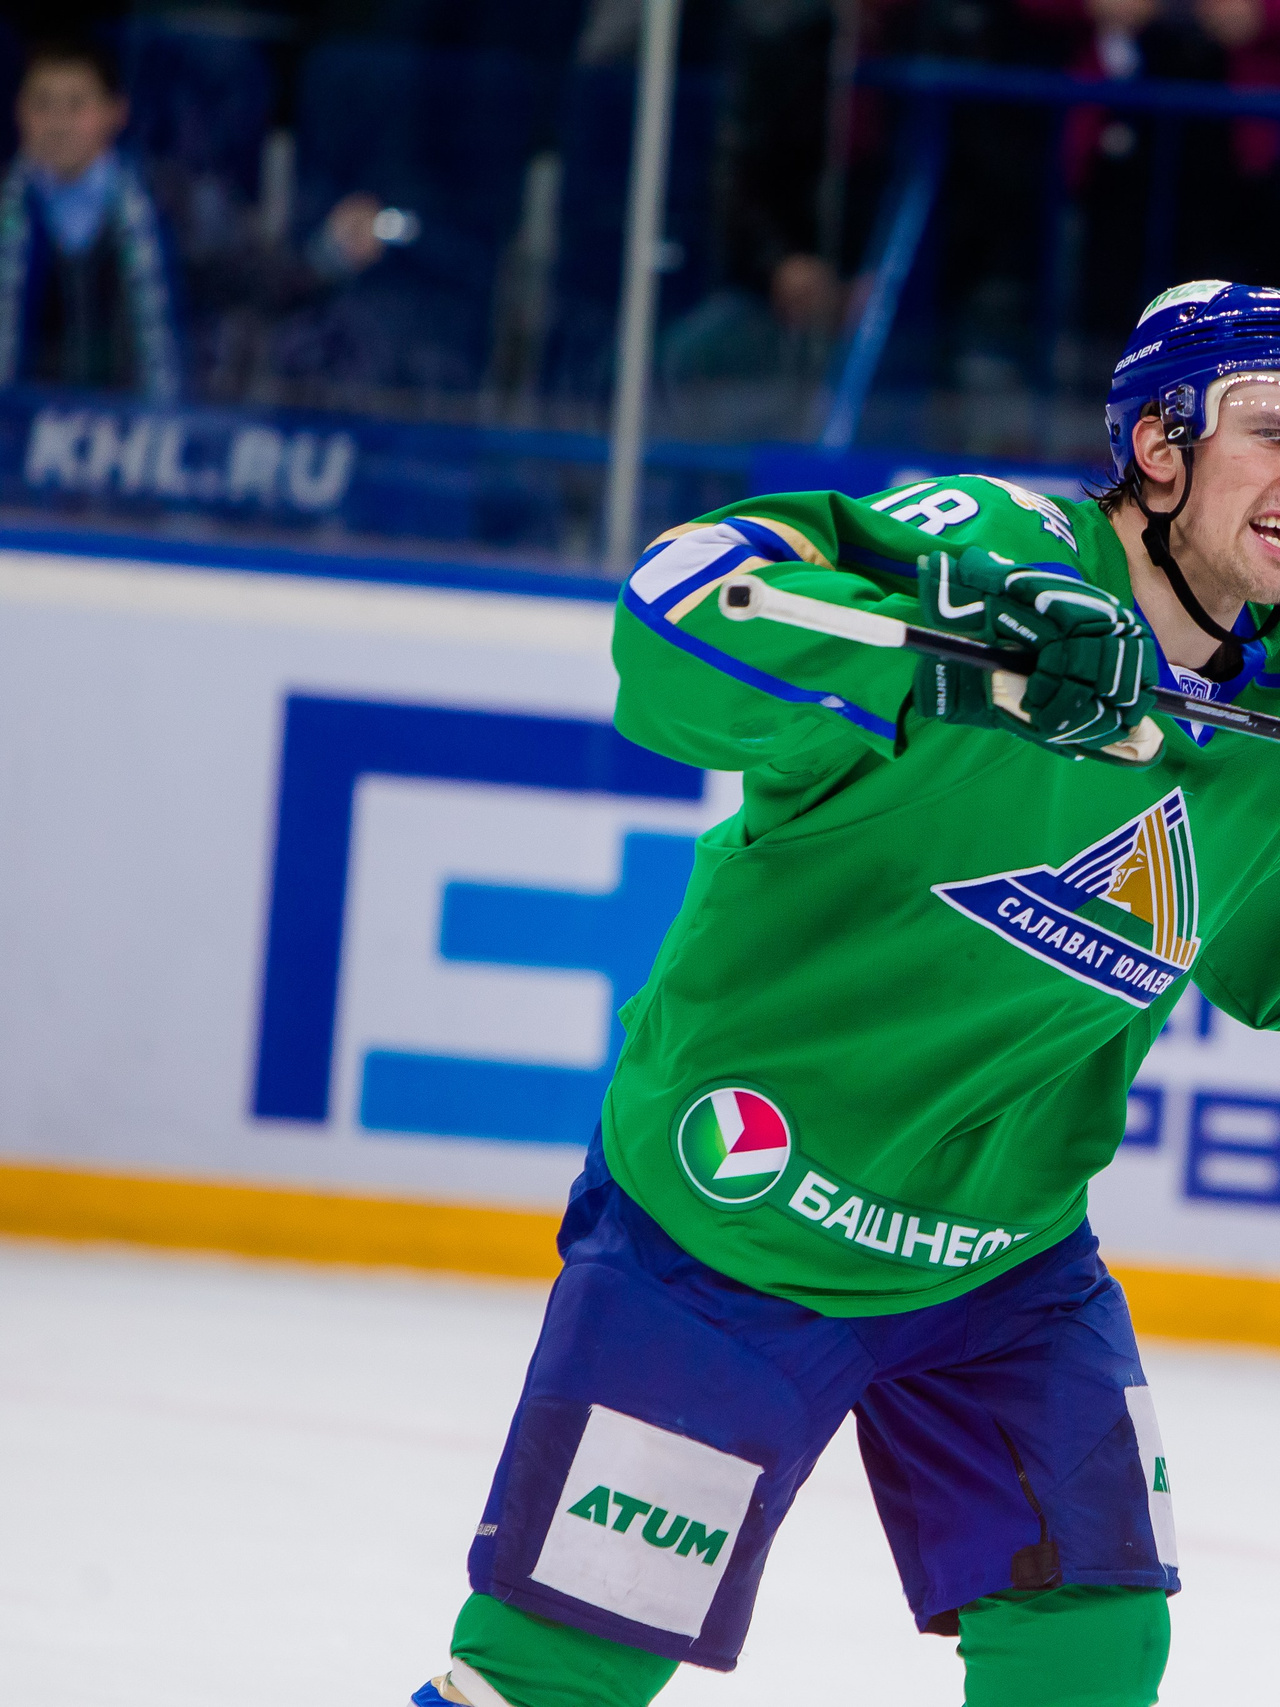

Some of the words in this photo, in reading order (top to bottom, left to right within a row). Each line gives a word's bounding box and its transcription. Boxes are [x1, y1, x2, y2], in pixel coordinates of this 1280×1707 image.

[1114, 340, 1163, 374] BAUER
[24, 410, 358, 512] KHL.RU
[869, 482, 981, 537] 18
[996, 896, 1114, 969] САЛАВАТ
[1110, 954, 1175, 996] ЮЛАЕВ
[566, 1484, 730, 1567] ATUM
